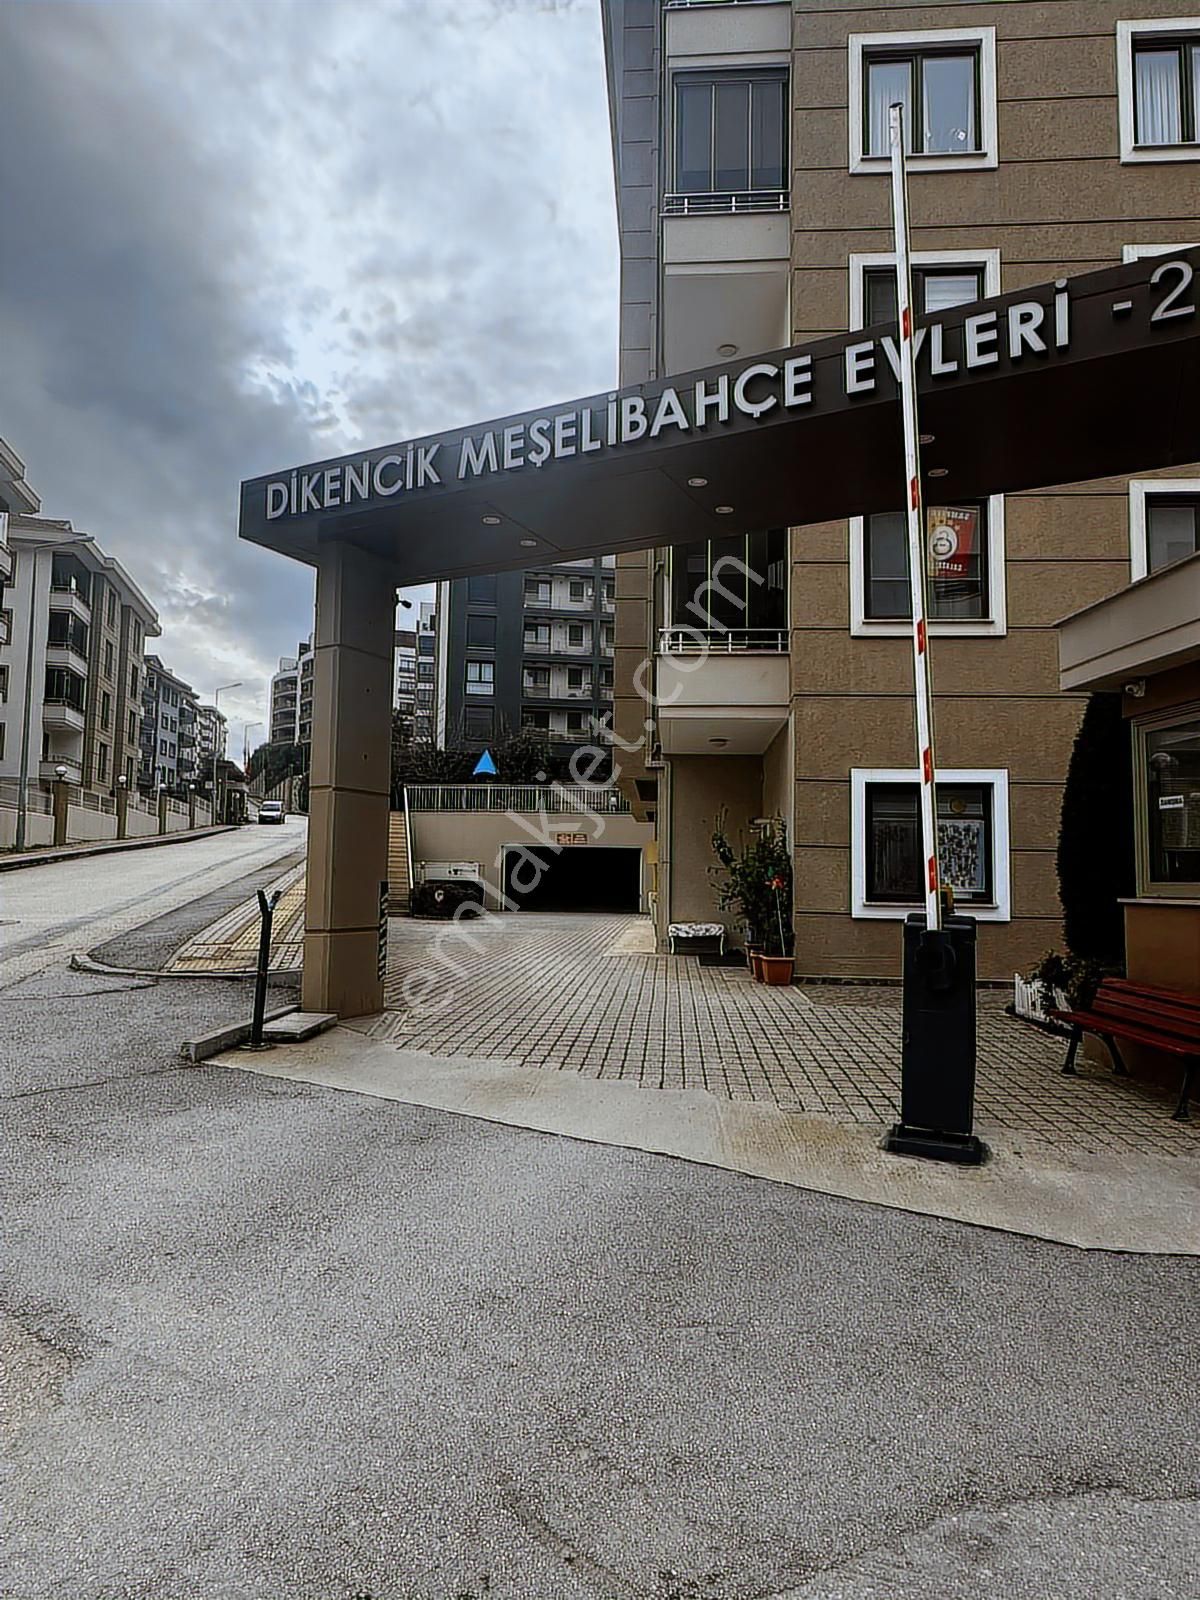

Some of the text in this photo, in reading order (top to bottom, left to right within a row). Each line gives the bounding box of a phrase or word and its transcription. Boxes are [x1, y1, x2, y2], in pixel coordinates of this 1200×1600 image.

[265, 442, 442, 520] DİKENCİK
[457, 354, 813, 479] MEŞELİBAHÇE
[845, 278, 1070, 394] EVLERİ
[1149, 260, 1196, 322] 2
